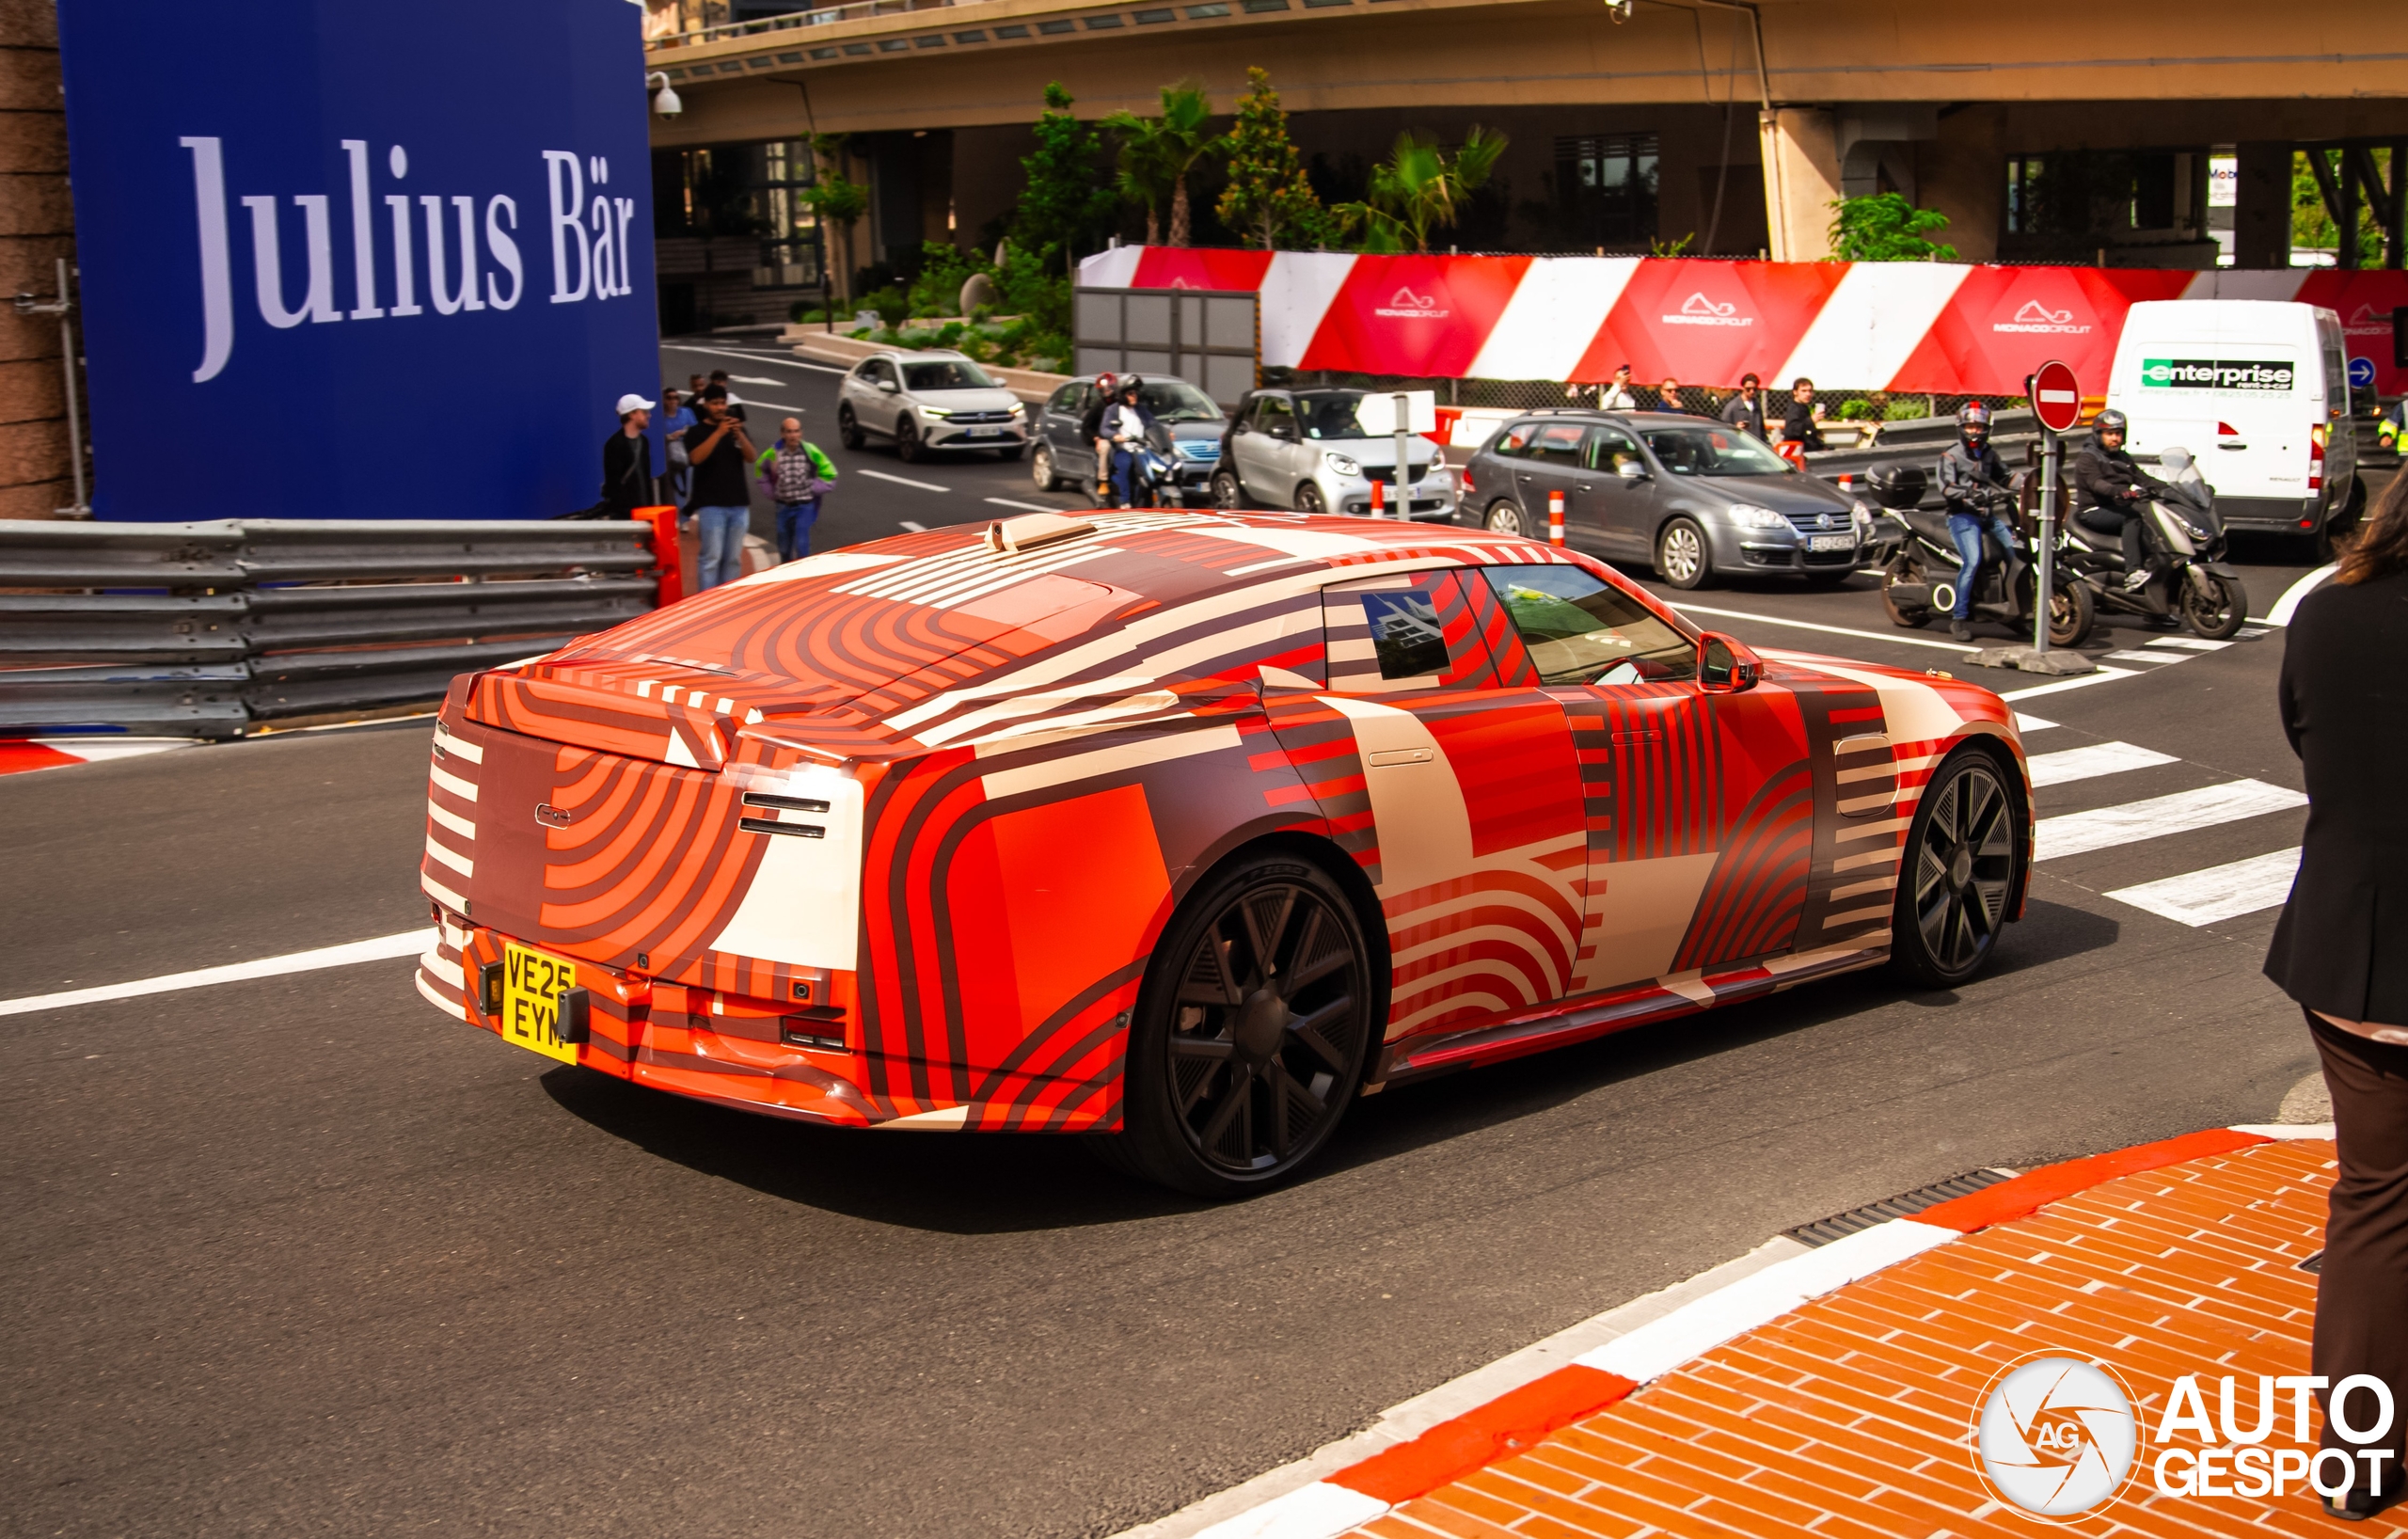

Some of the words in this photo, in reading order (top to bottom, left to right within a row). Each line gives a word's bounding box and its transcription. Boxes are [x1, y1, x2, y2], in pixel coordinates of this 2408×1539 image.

[180, 136, 523, 384] Julius
[542, 150, 635, 303] Bär
[2142, 364, 2292, 387] enterprise
[508, 949, 571, 1000] VE25
